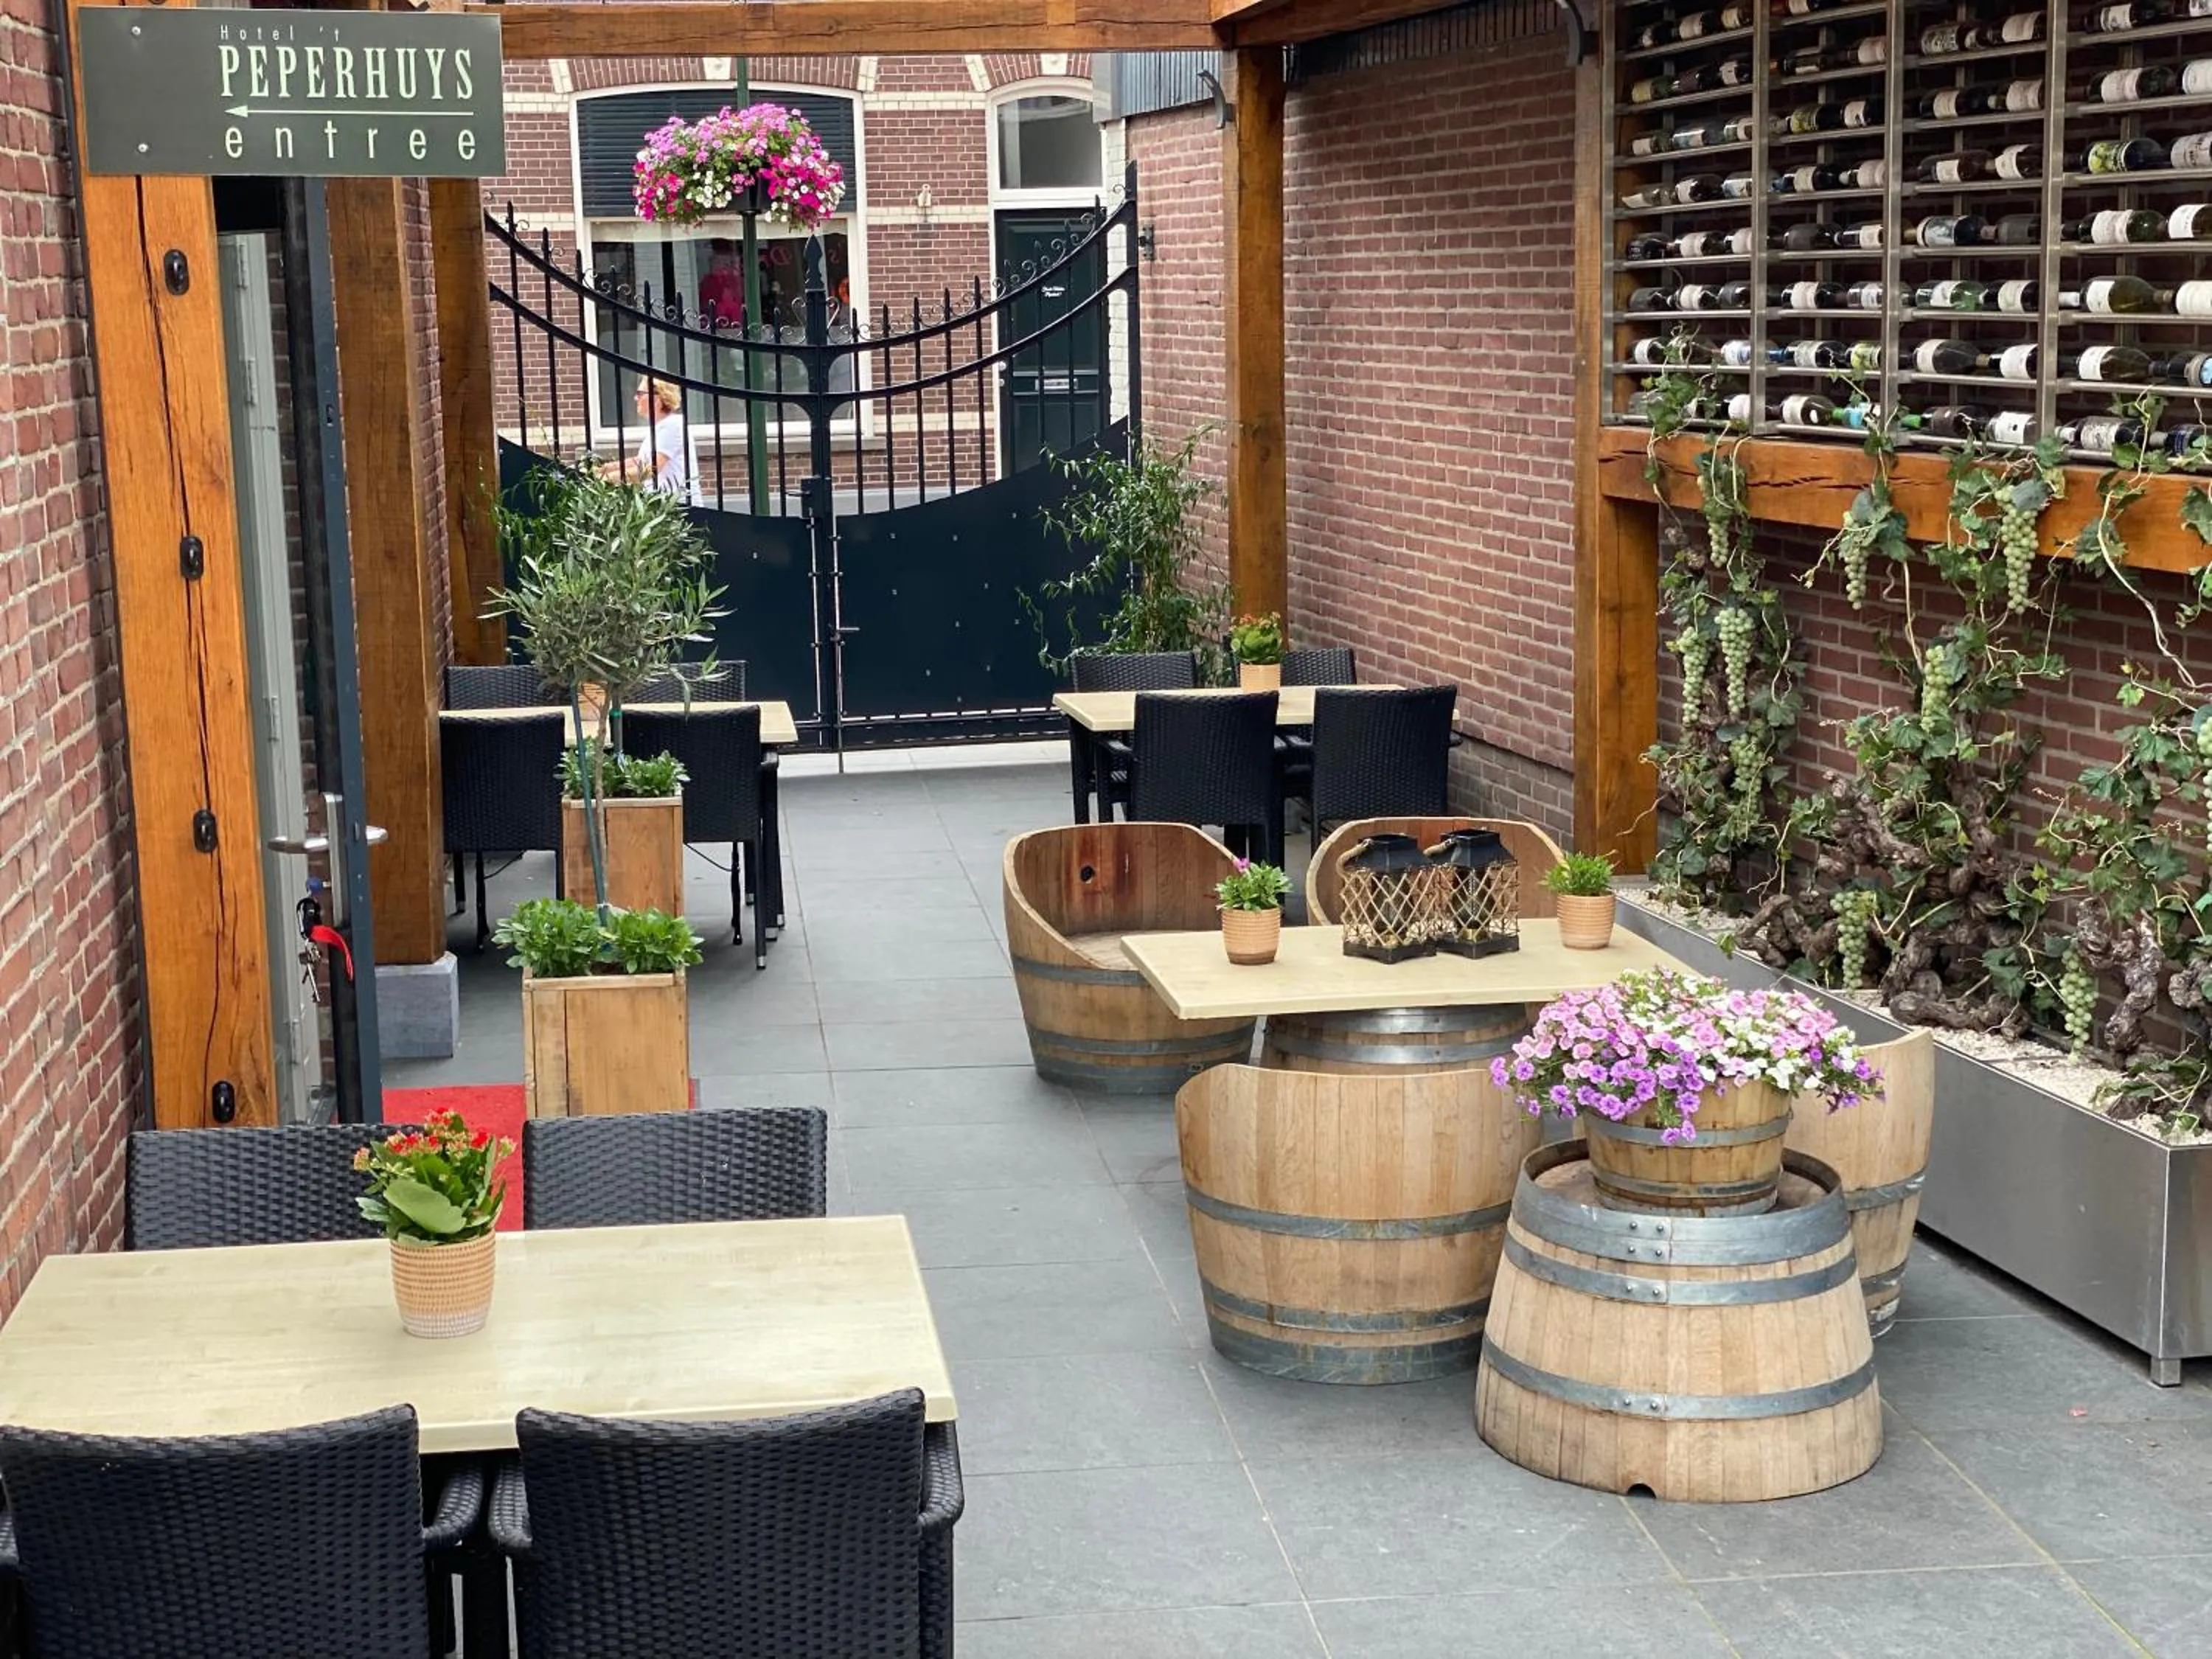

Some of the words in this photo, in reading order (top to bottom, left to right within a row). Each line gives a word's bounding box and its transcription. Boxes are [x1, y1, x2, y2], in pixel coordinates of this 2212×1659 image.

[220, 24, 294, 41] Hotel
[218, 45, 473, 100] PEPERHUYS
[225, 120, 476, 160] entree
